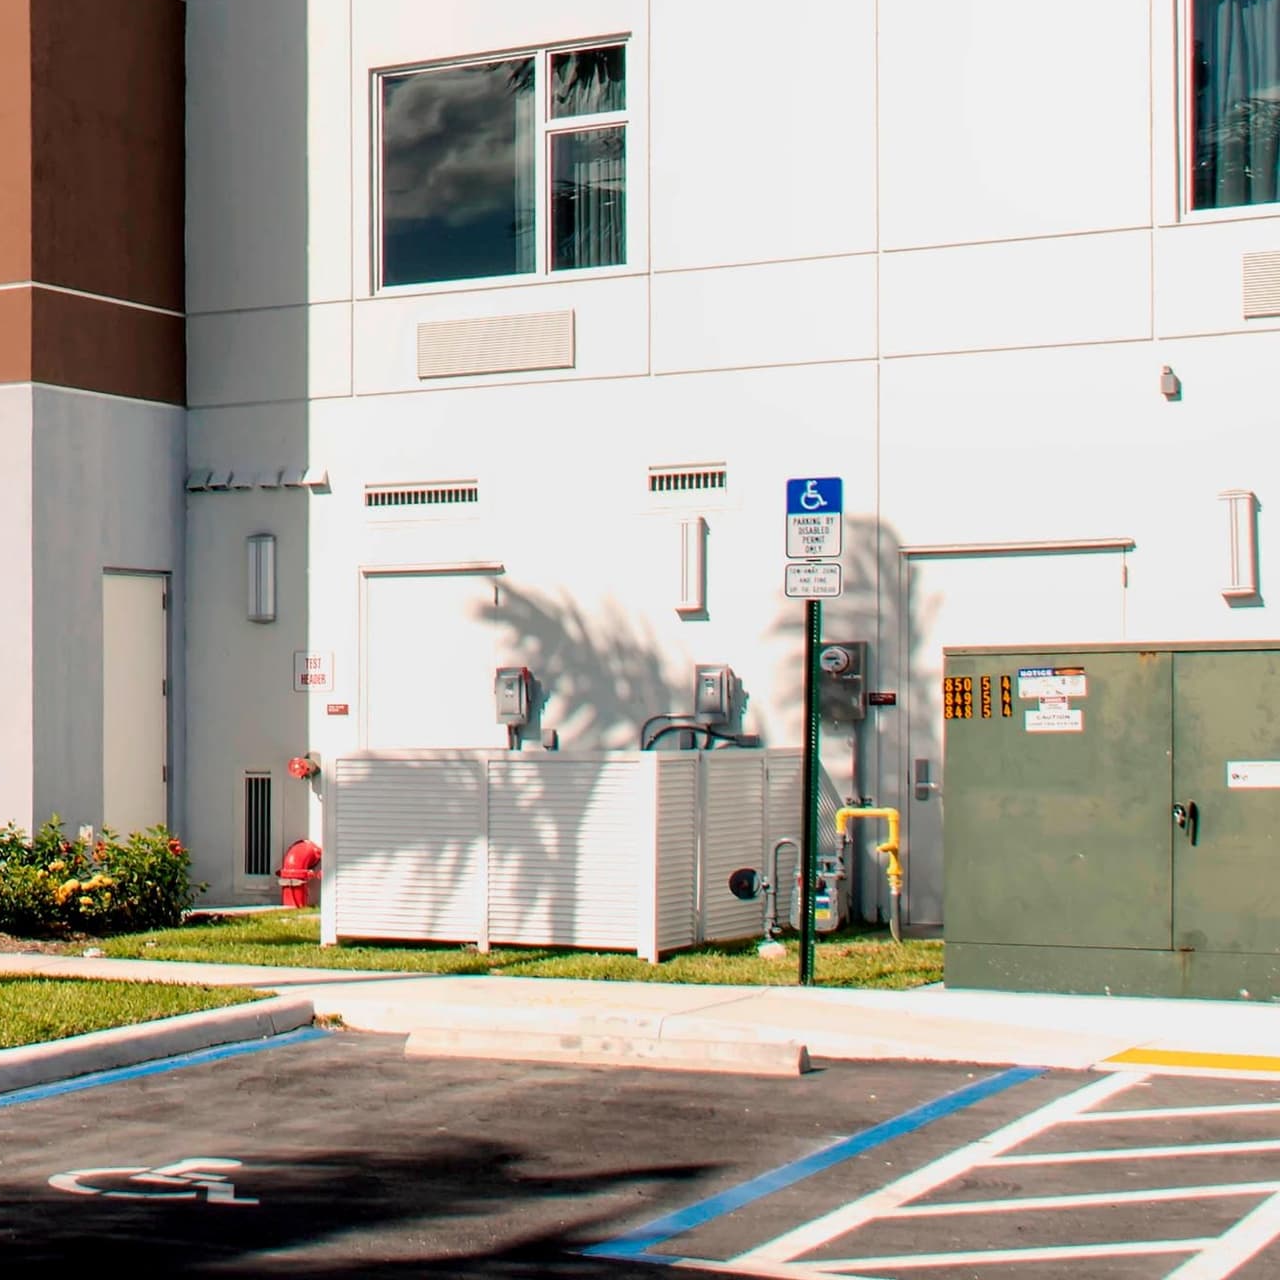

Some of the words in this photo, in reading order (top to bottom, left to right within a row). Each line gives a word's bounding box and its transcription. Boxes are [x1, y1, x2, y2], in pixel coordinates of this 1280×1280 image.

[793, 517, 821, 526] PARKING
[798, 526, 830, 535] DISABLED
[802, 535, 825, 544] PERMIT
[805, 545, 822, 554] ONLY
[305, 657, 321, 669] TEST
[1020, 669, 1053, 677] NOTICE
[945, 678, 972, 692] 850
[982, 677, 990, 690] 5
[1002, 677, 1010, 690] 4
[945, 691, 972, 705] 849
[983, 691, 991, 704] 5
[1003, 690, 1011, 704] 4
[945, 705, 972, 719] 848
[983, 705, 991, 718] 5
[1003, 704, 1012, 718] 4
